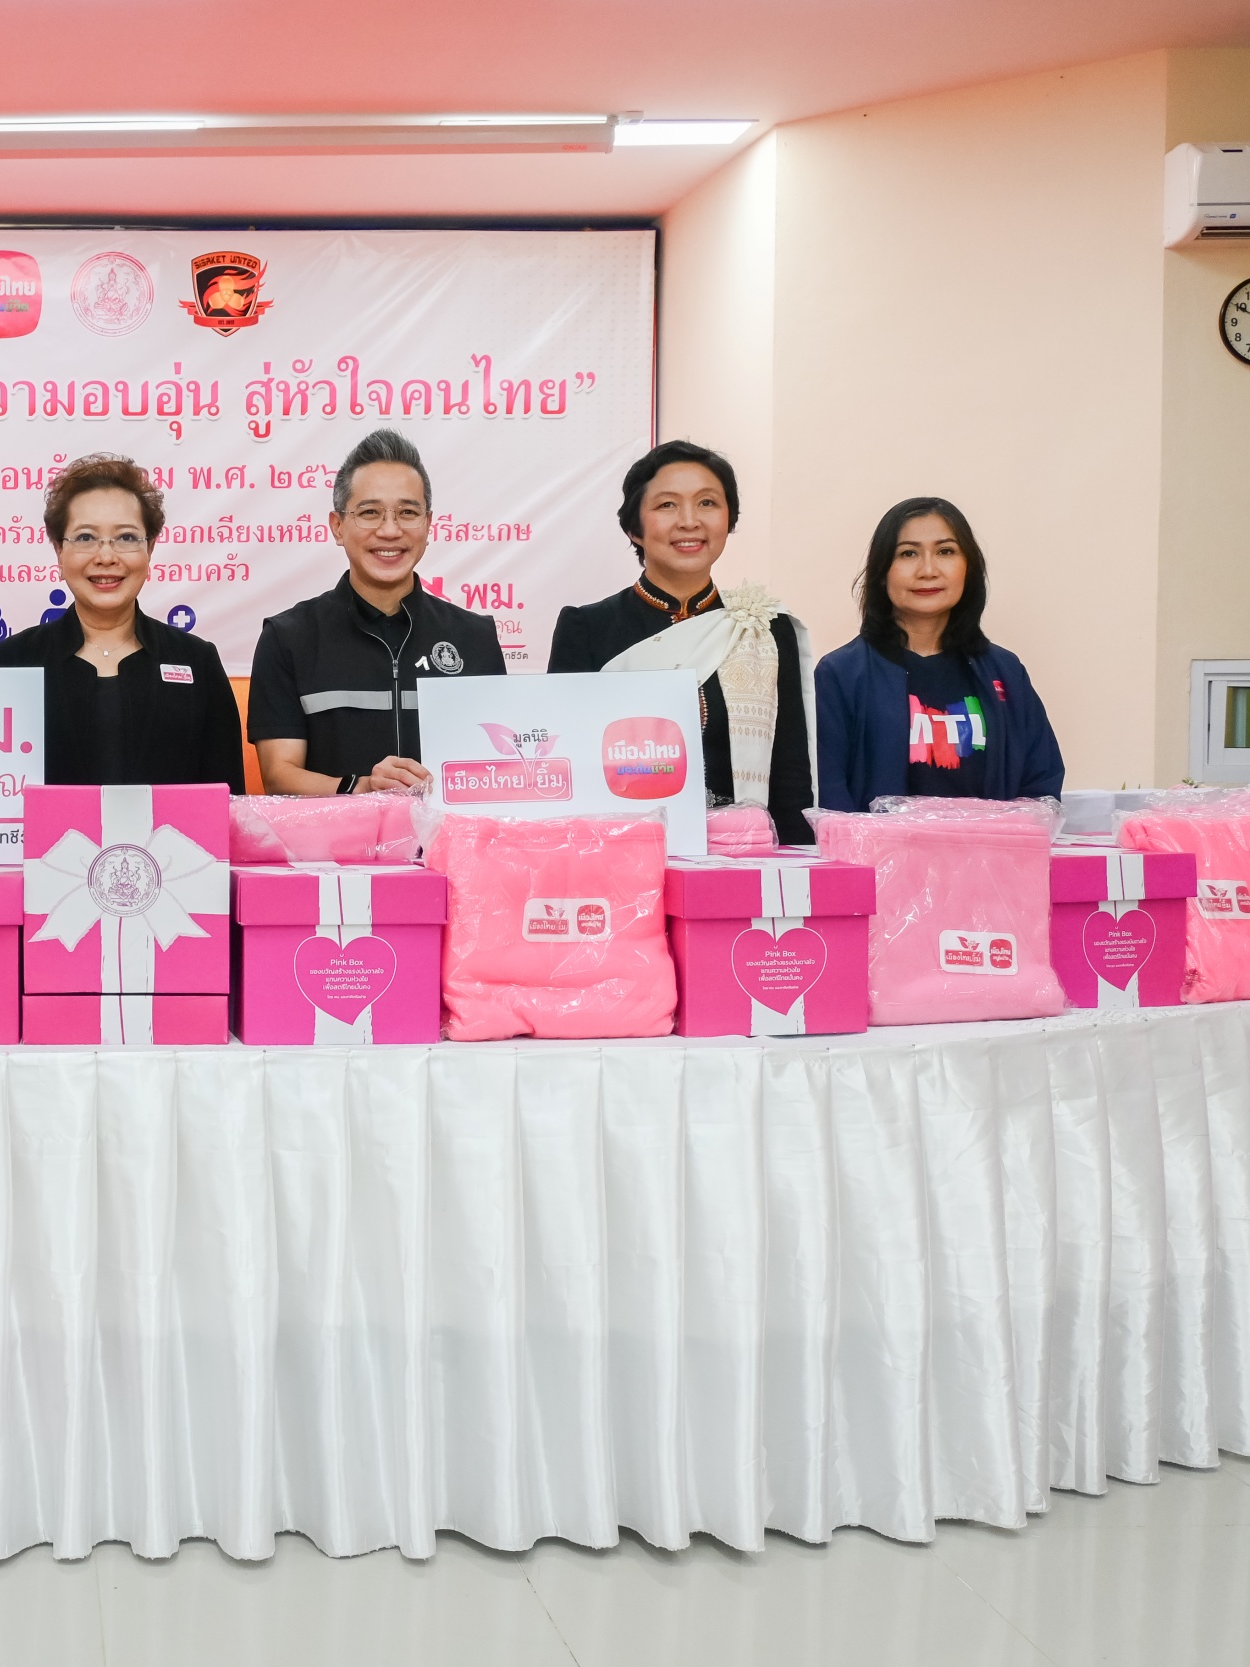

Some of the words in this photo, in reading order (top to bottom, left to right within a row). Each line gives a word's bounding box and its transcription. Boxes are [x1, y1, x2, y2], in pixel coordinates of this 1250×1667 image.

[230, 255, 258, 269] UNITED
[1235, 302, 1247, 312] 10
[1231, 317, 1238, 326] 9
[1234, 332, 1242, 342] 8
[188, 464, 256, 490] พ.ศ.
[461, 583, 525, 609] พม.
[513, 729, 549, 748] มูลนิธิ
[607, 740, 681, 760] เมืองไทย
[447, 765, 525, 790] เมืองไทย
[537, 762, 563, 788] ยิ้ม
